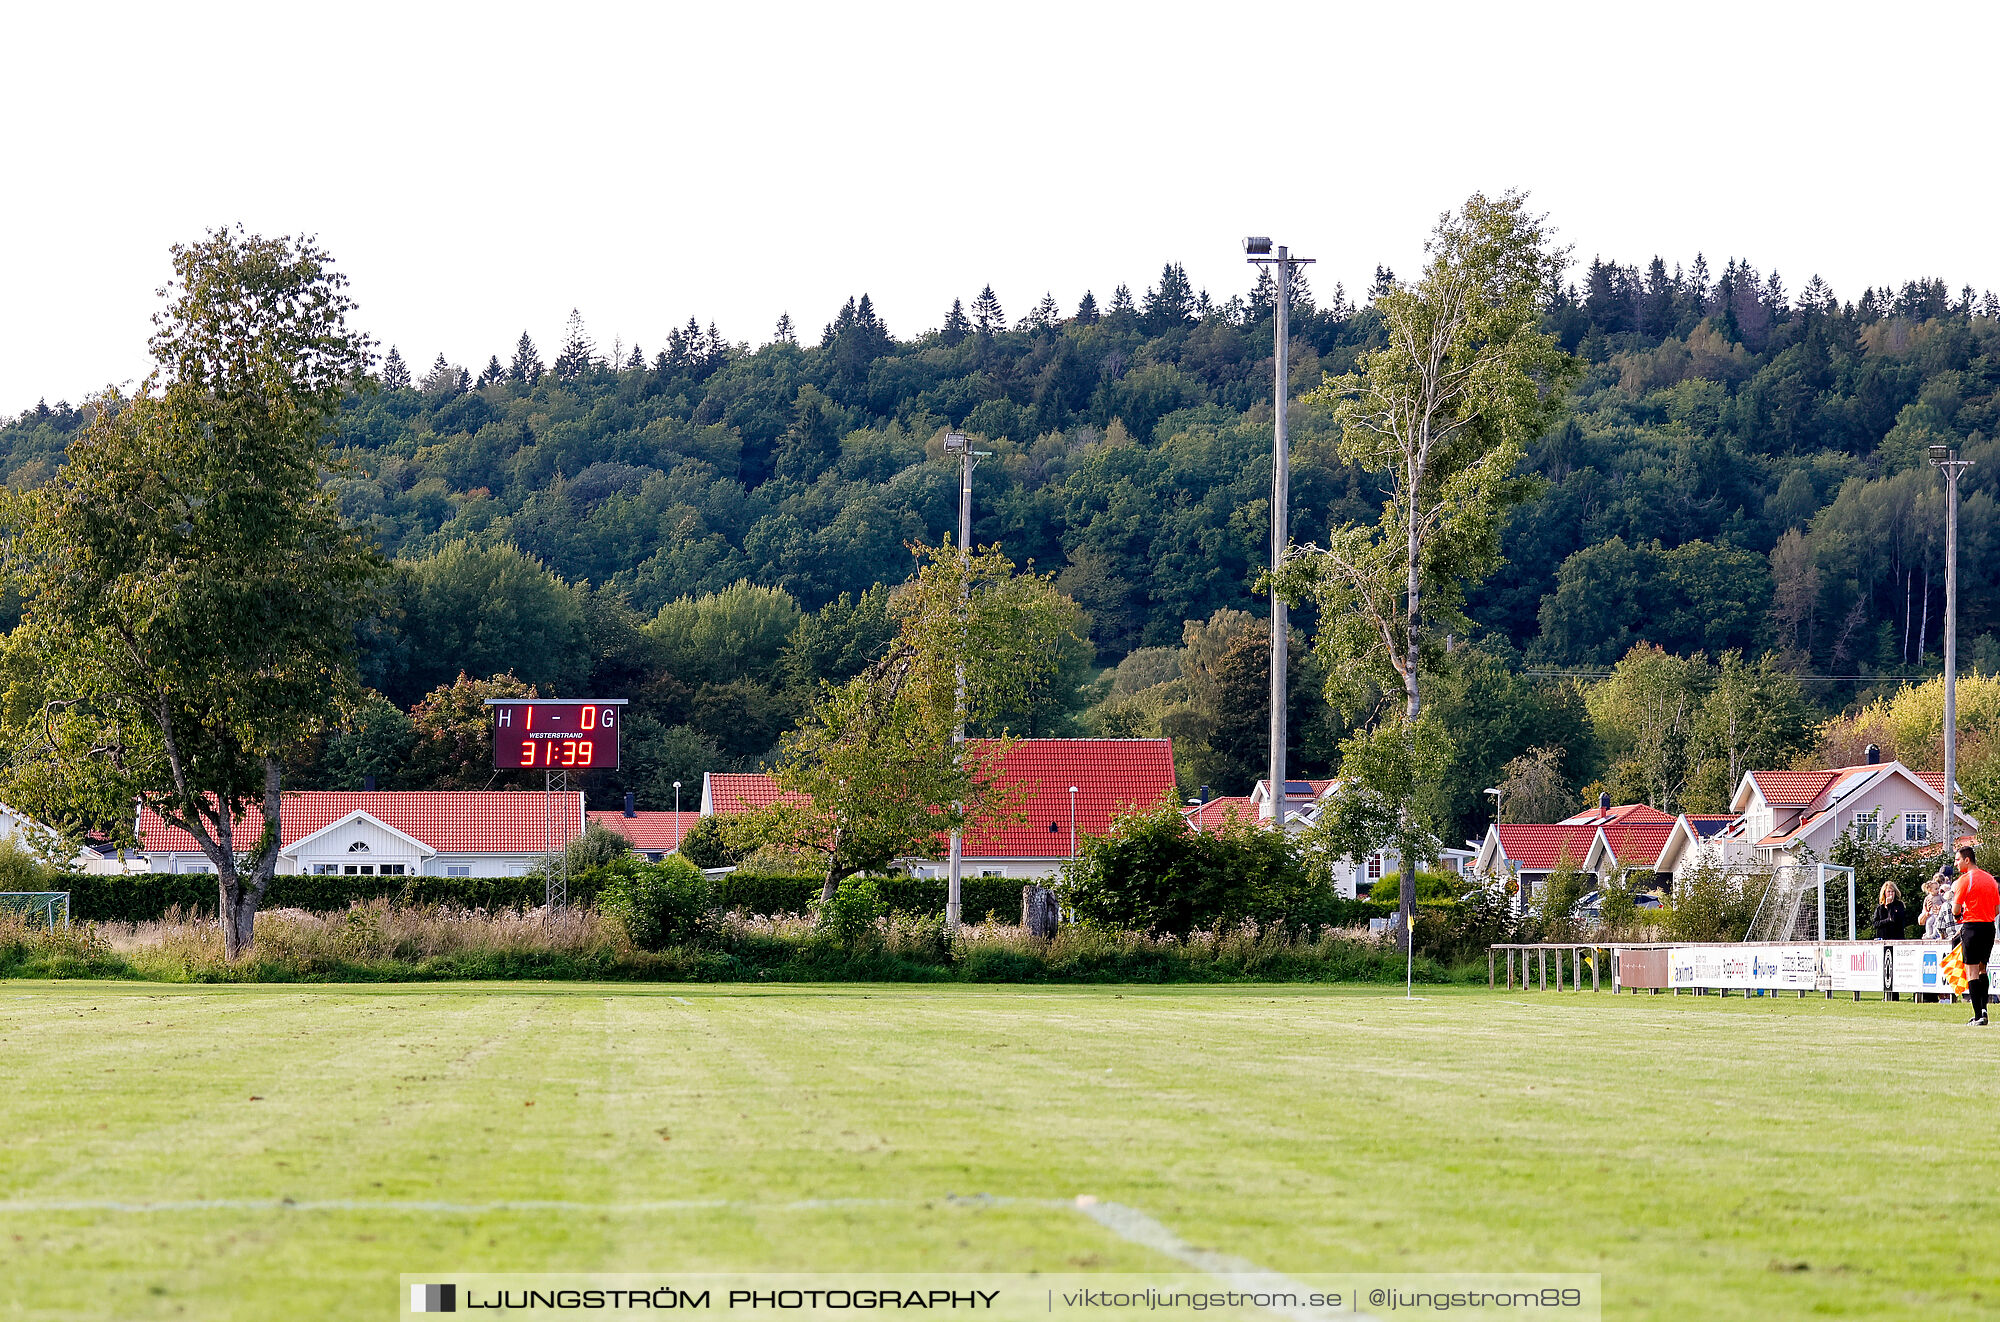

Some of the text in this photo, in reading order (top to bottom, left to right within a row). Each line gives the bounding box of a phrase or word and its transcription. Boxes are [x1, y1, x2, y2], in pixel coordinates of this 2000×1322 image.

[498, 709, 512, 728] H
[526, 706, 533, 730] 1
[580, 706, 596, 730] 0
[601, 709, 614, 728] G
[520, 741, 593, 766] 31:39
